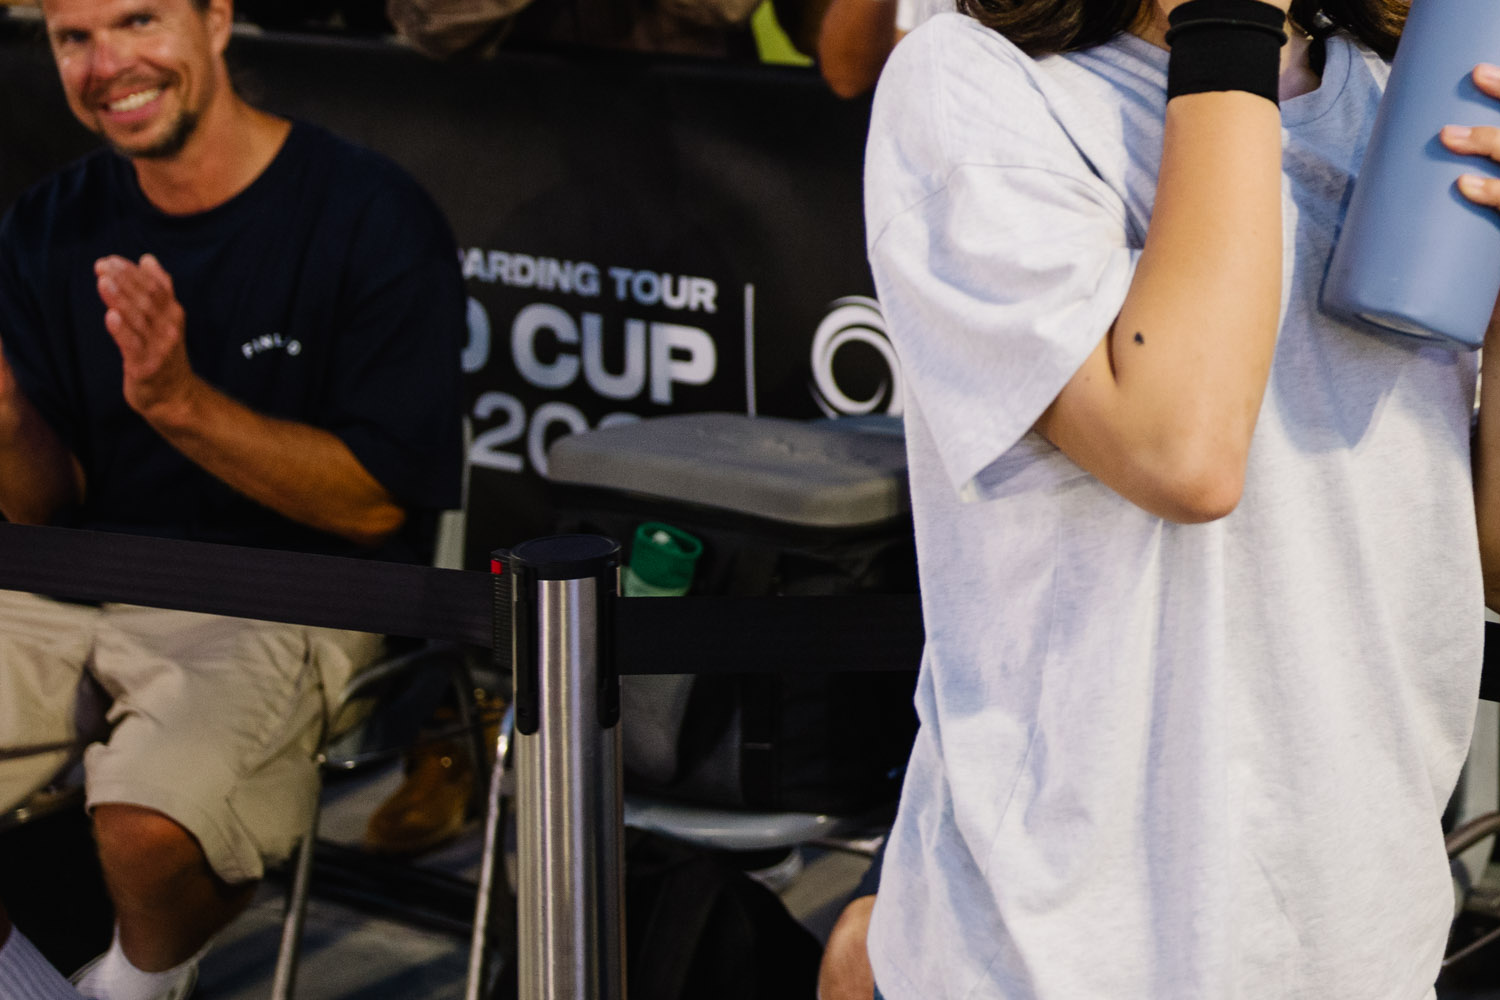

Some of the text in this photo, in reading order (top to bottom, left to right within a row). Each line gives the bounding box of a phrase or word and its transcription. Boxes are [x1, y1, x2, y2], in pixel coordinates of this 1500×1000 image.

[458, 247, 718, 314] ARDING TOUR
[510, 302, 718, 406] CUP
